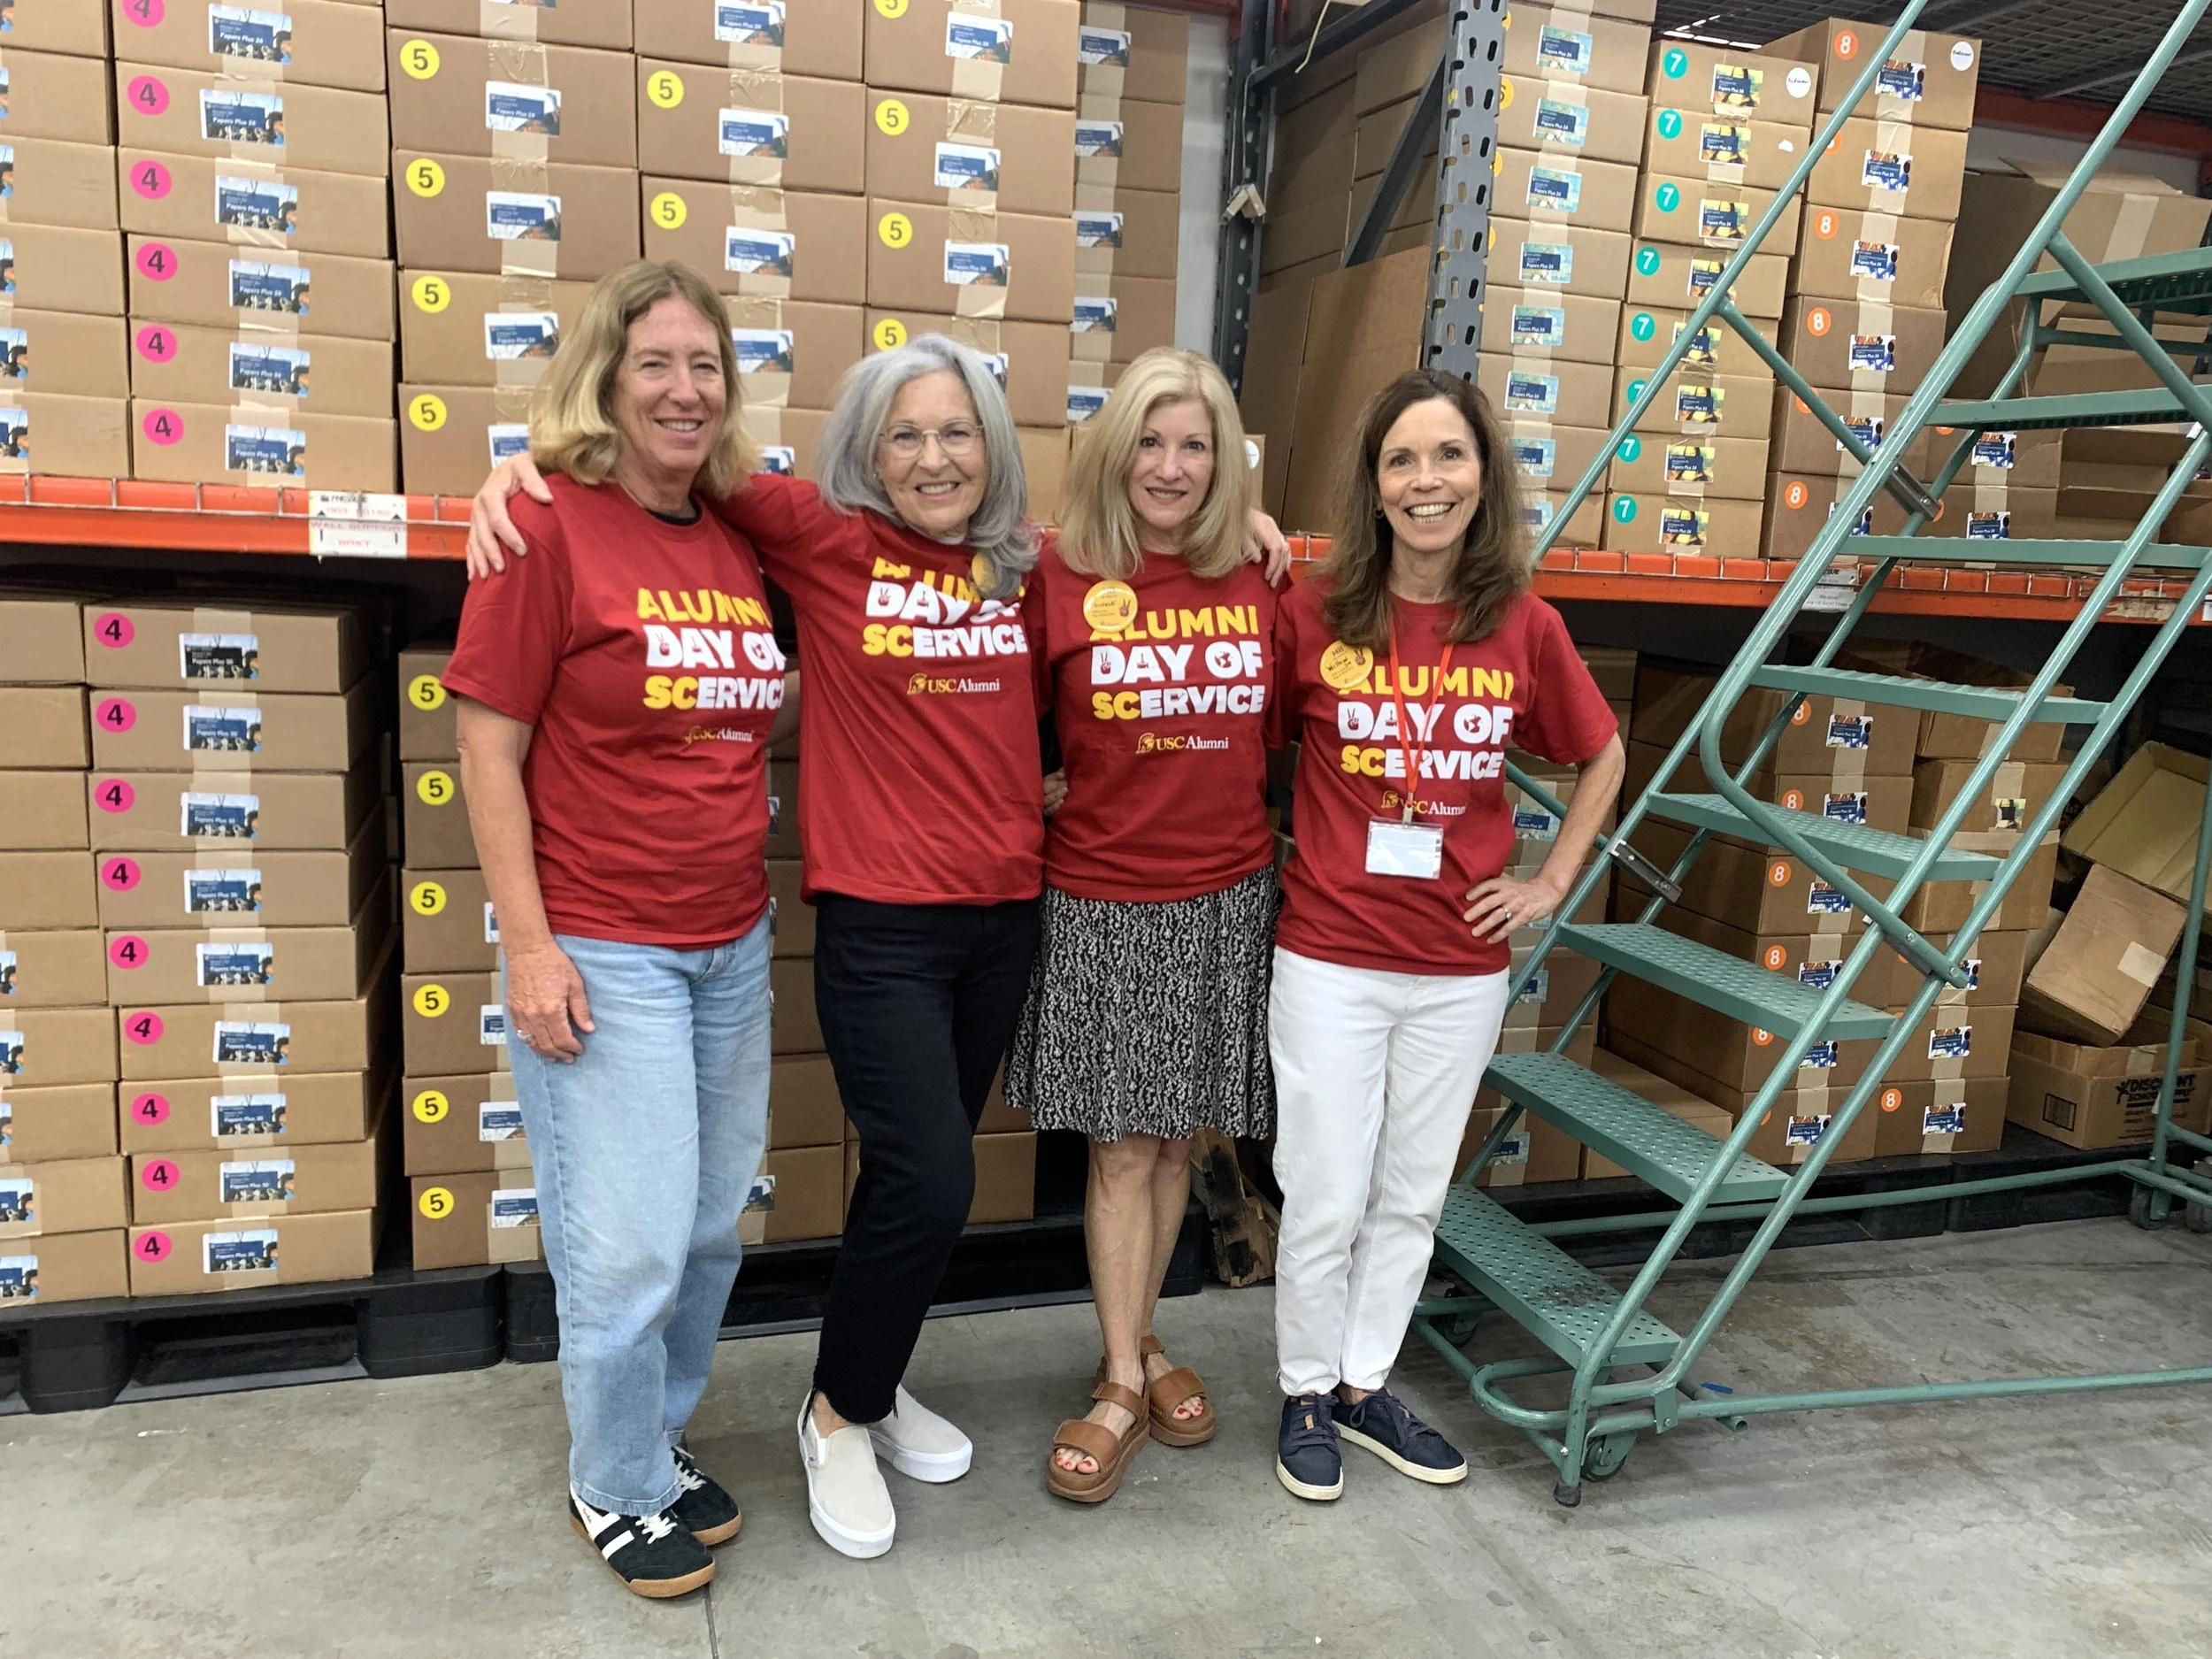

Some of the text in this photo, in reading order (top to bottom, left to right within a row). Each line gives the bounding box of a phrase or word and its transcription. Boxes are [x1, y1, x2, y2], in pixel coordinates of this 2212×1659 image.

[134, 0, 149, 18] 4
[1842, 35, 1850, 54] 8
[414, 49, 428, 70] 5
[1671, 53, 1682, 72] 7
[141, 84, 156, 105] 4
[659, 79, 672, 99] 5
[886, 108, 898, 127] 5
[1665, 113, 1676, 133] 7
[142, 168, 158, 190] 4
[419, 167, 433, 188] 5
[1663, 188, 1674, 206] 7
[664, 202, 675, 221] 5
[890, 221, 902, 241] 5
[1821, 216, 1830, 234] 8
[148, 251, 165, 273] 4
[1644, 251, 1654, 270] 7
[425, 284, 439, 304] 5
[1639, 317, 1649, 335] 7
[1814, 312, 1823, 331] 8
[148, 333, 165, 354] 4
[885, 327, 896, 346] 5
[421, 403, 436, 423] 5
[156, 416, 171, 436] 4
[1625, 439, 1635, 457] 7
[1792, 486, 1801, 503] 8
[1619, 500, 1630, 518] 7
[866, 580, 971, 625] DAY
[105, 619, 121, 641] 4
[642, 624, 735, 669] DAY
[863, 624, 1028, 657] SCERVICE
[1091, 641, 1263, 685] DAY OF
[420, 682, 434, 703] 5
[642, 675, 786, 710] SCERVIC
[1092, 685, 1265, 720] SCERVICE
[107, 704, 124, 726] 4
[1338, 702, 1514, 745] DAY OF
[106, 786, 122, 806] 4
[429, 778, 443, 798] 5
[1787, 794, 1796, 810] 8
[112, 864, 128, 884] 4
[1774, 866, 1785, 881] 8
[421, 888, 435, 908] 5
[120, 941, 136, 962] 4
[1770, 950, 1779, 964] 8
[426, 991, 439, 1010] 5
[134, 1018, 150, 1037] 4
[142, 1099, 157, 1118] 4
[425, 1097, 439, 1116] 5
[1886, 1093, 1895, 1107] 8
[153, 1165, 168, 1184] 4
[430, 1193, 444, 1212] 5
[144, 1237, 160, 1256] 4
